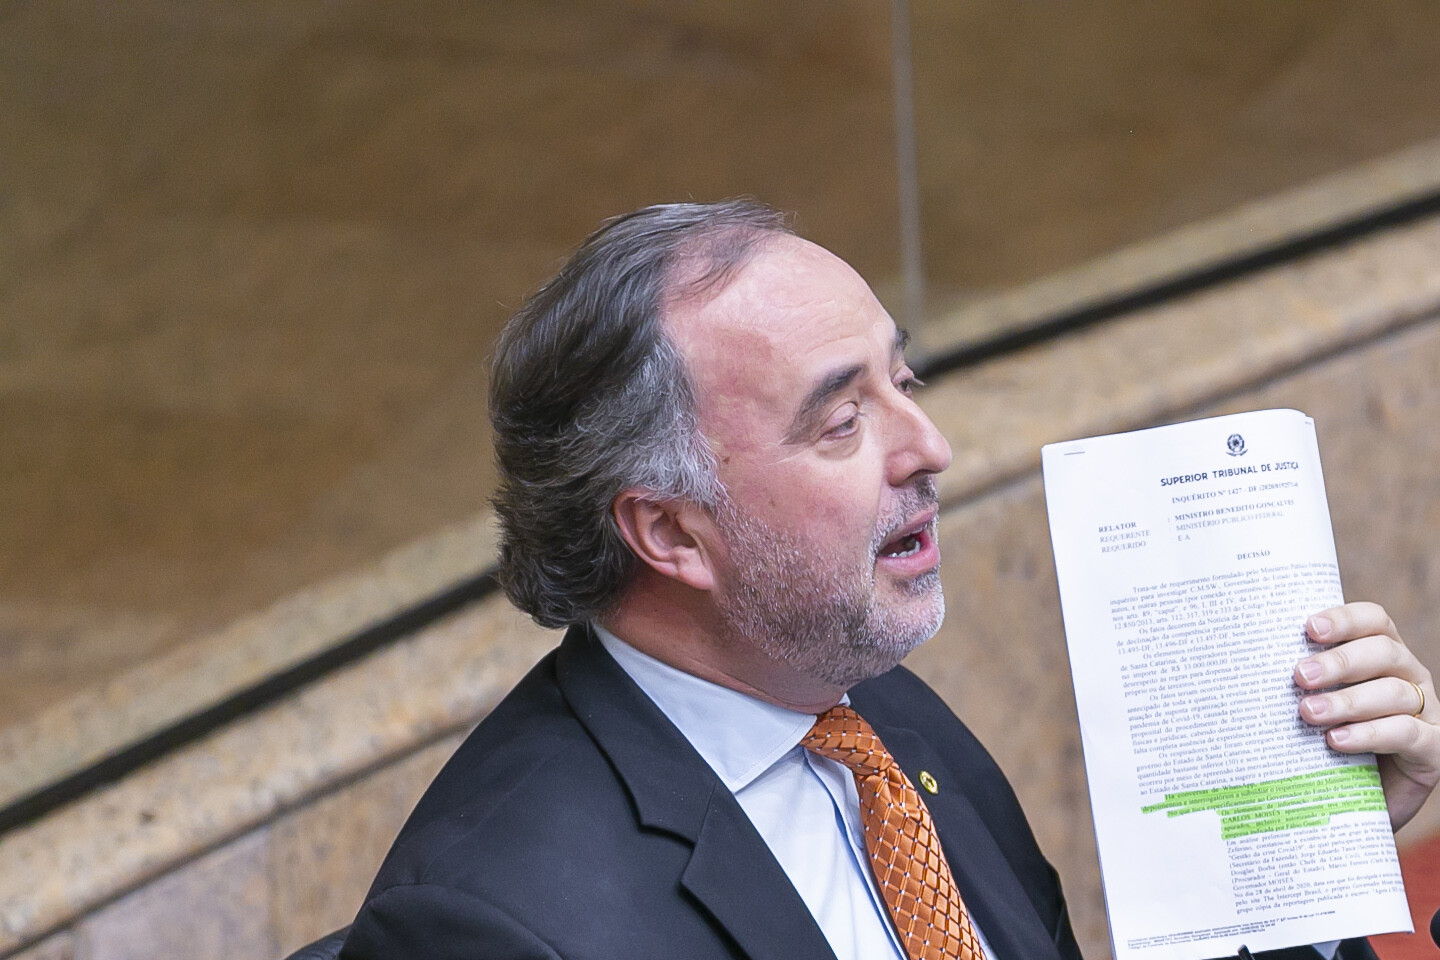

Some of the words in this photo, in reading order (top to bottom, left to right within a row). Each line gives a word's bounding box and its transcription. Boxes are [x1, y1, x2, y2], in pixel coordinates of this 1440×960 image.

[1160, 472, 1208, 486] SUPERIOR
[1212, 465, 1258, 478] TRIBUNAL
[1261, 464, 1271, 472] DE
[1172, 491, 1216, 504] INQUÉRITO
[1098, 522, 1136, 532] RELATOR
[1174, 510, 1214, 521] MINISTRO
[1215, 504, 1254, 515] BENEDITO
[1099, 530, 1150, 543] REQUERENTE
[1176, 518, 1220, 531] MINISTÉRIO
[1101, 540, 1146, 553] REQUERIDO
[1236, 549, 1270, 560] DECISÃO
